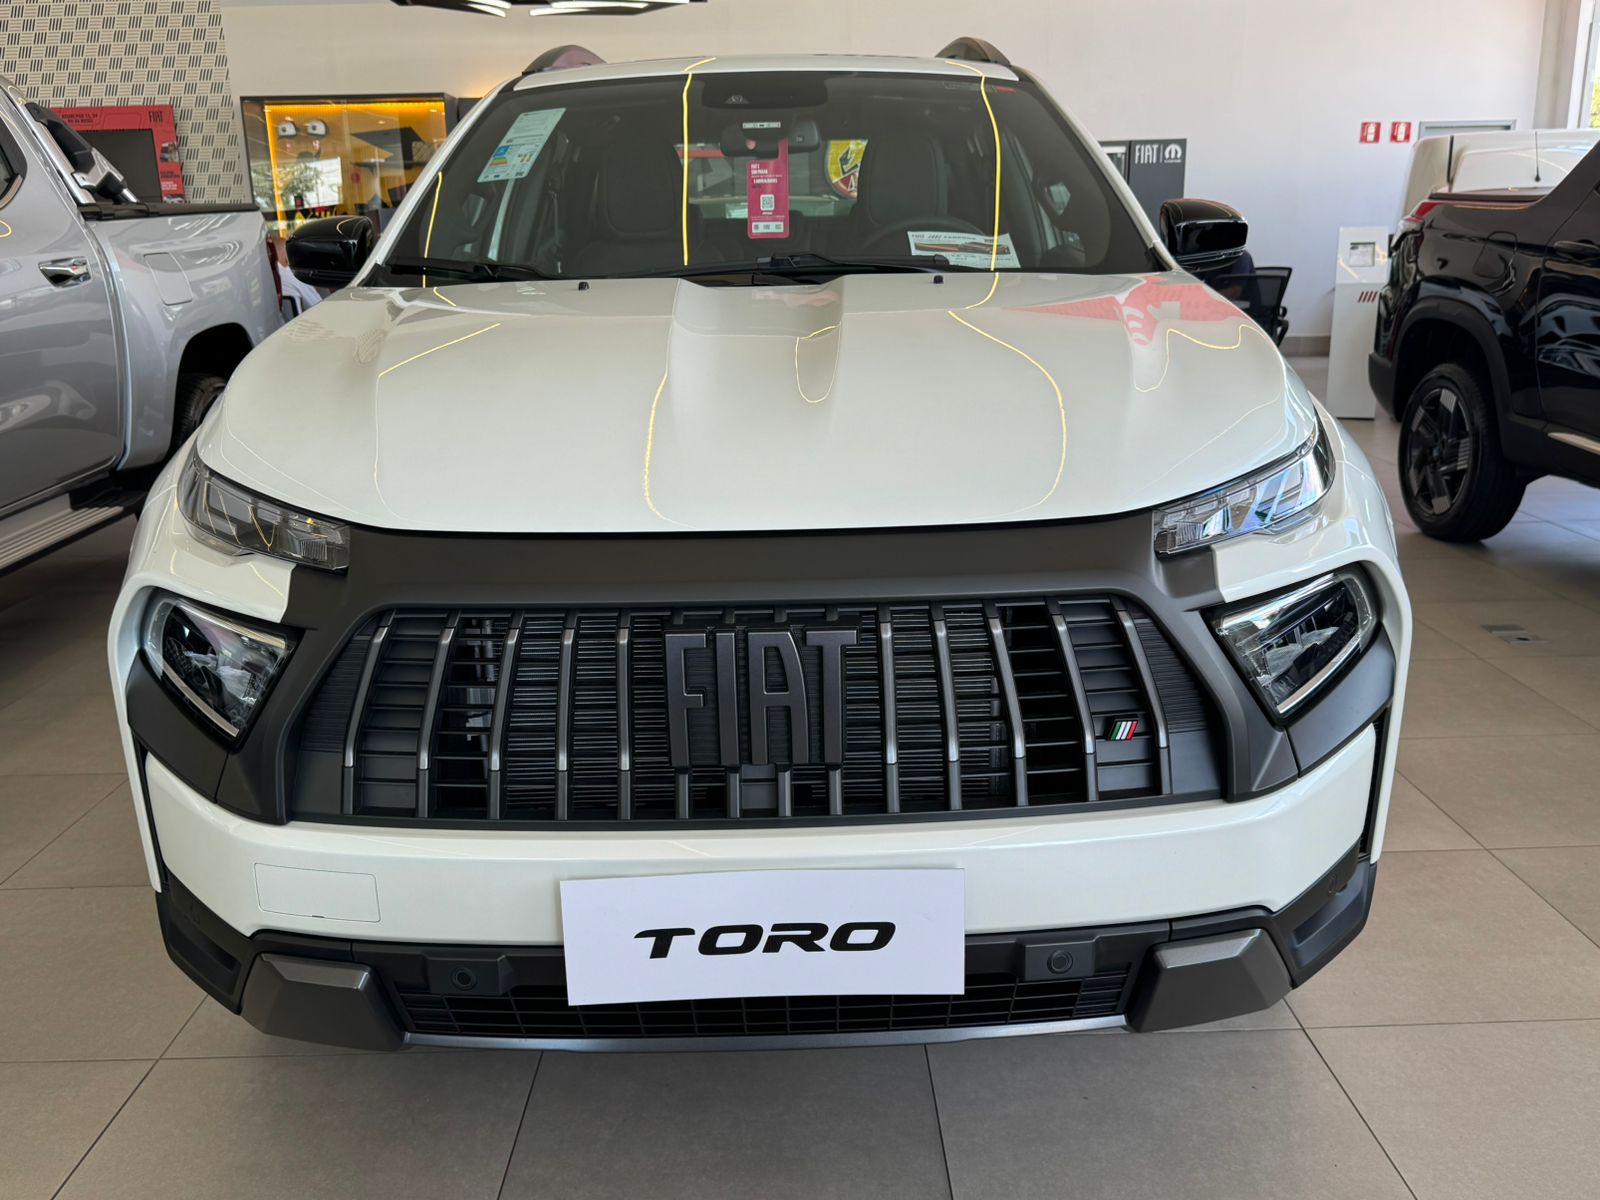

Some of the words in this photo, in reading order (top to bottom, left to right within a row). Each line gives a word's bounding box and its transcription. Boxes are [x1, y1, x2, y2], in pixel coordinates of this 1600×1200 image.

[1135, 144, 1159, 164] FIAT
[665, 630, 857, 767] FIAT
[633, 921, 896, 959] TORO
